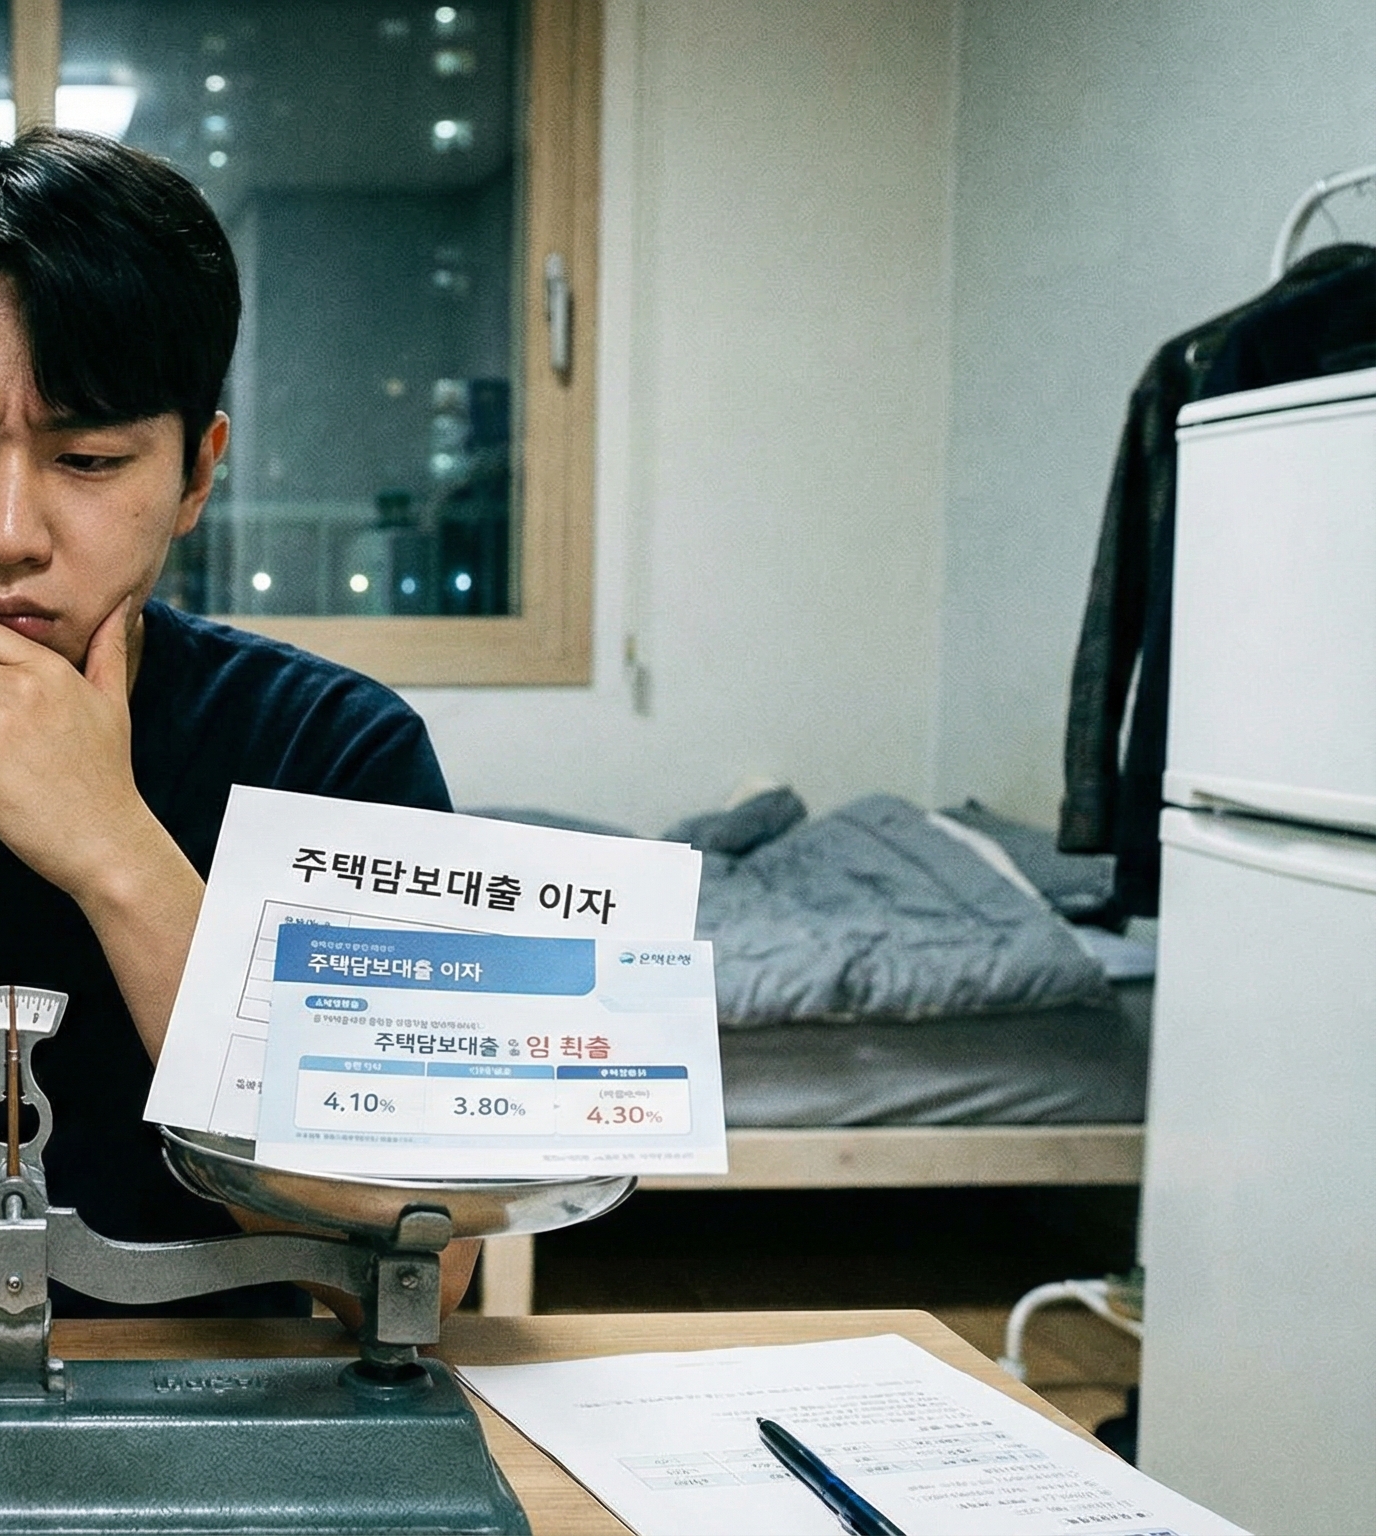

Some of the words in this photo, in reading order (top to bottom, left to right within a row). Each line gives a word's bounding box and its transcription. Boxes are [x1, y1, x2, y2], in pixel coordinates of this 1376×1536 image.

[292, 847, 522, 912] 주택담보대출
[538, 883, 617, 925] 이자
[440, 961, 483, 982] 이자
[374, 1032, 500, 1058] 주택담보대출
[323, 1091, 396, 1114] 4.10%
[453, 1096, 526, 1117] 3.80%
[586, 1105, 663, 1126] 4.30%
